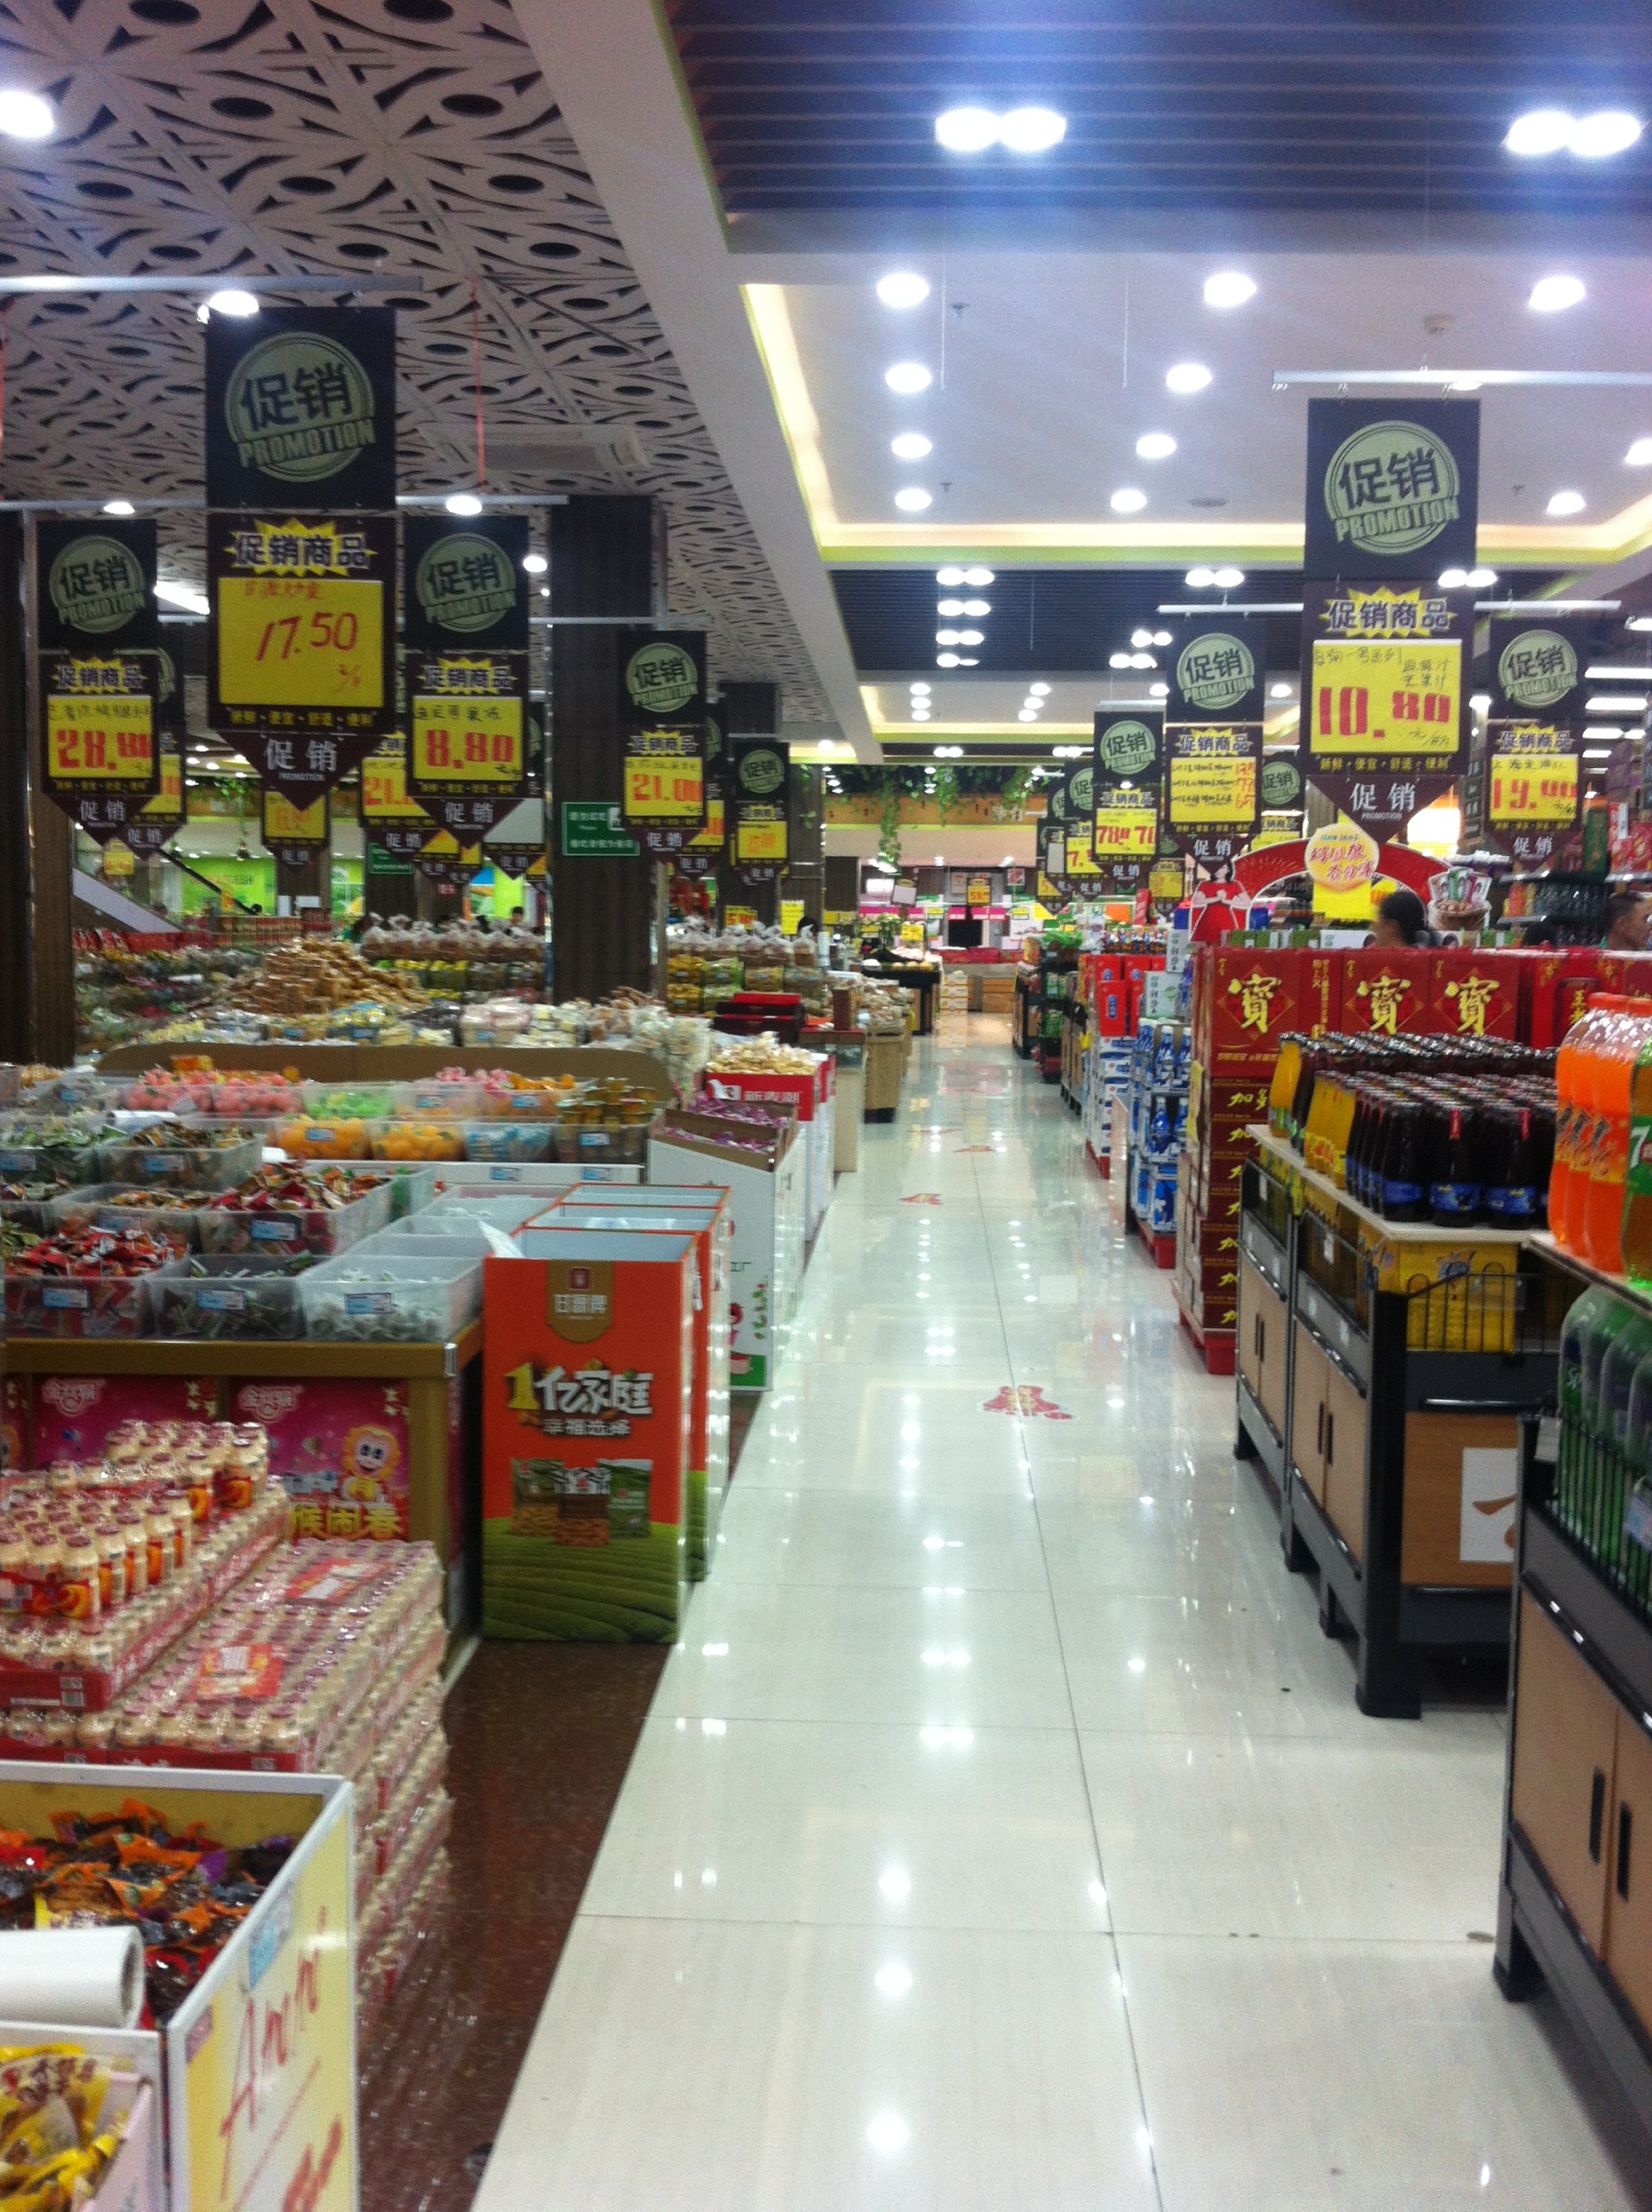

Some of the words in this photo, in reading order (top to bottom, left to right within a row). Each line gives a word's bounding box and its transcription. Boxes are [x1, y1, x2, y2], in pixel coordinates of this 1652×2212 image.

[240, 362, 352, 432] 促销
[1339, 446, 1440, 510] 促销
[1335, 497, 1460, 543] PROMOTION
[235, 531, 370, 570] 促销商品
[60, 556, 130, 599] 促销
[428, 553, 502, 599] 促销
[1328, 599, 1451, 632] 促销商品
[256, 612, 358, 661] 17.50
[635, 657, 689, 688] 促销
[1185, 648, 1242, 684] 促销
[1506, 644, 1567, 683] 促销
[265, 738, 338, 771] 促销
[1108, 731, 1149, 756] 促销
[1180, 733, 1249, 754] 促销商品
[1349, 782, 1416, 812] 促销
[1194, 839, 1232, 856] 促销
[1514, 837, 1553, 855] 促销
[504, 1363, 654, 1416] 1亿家庭
